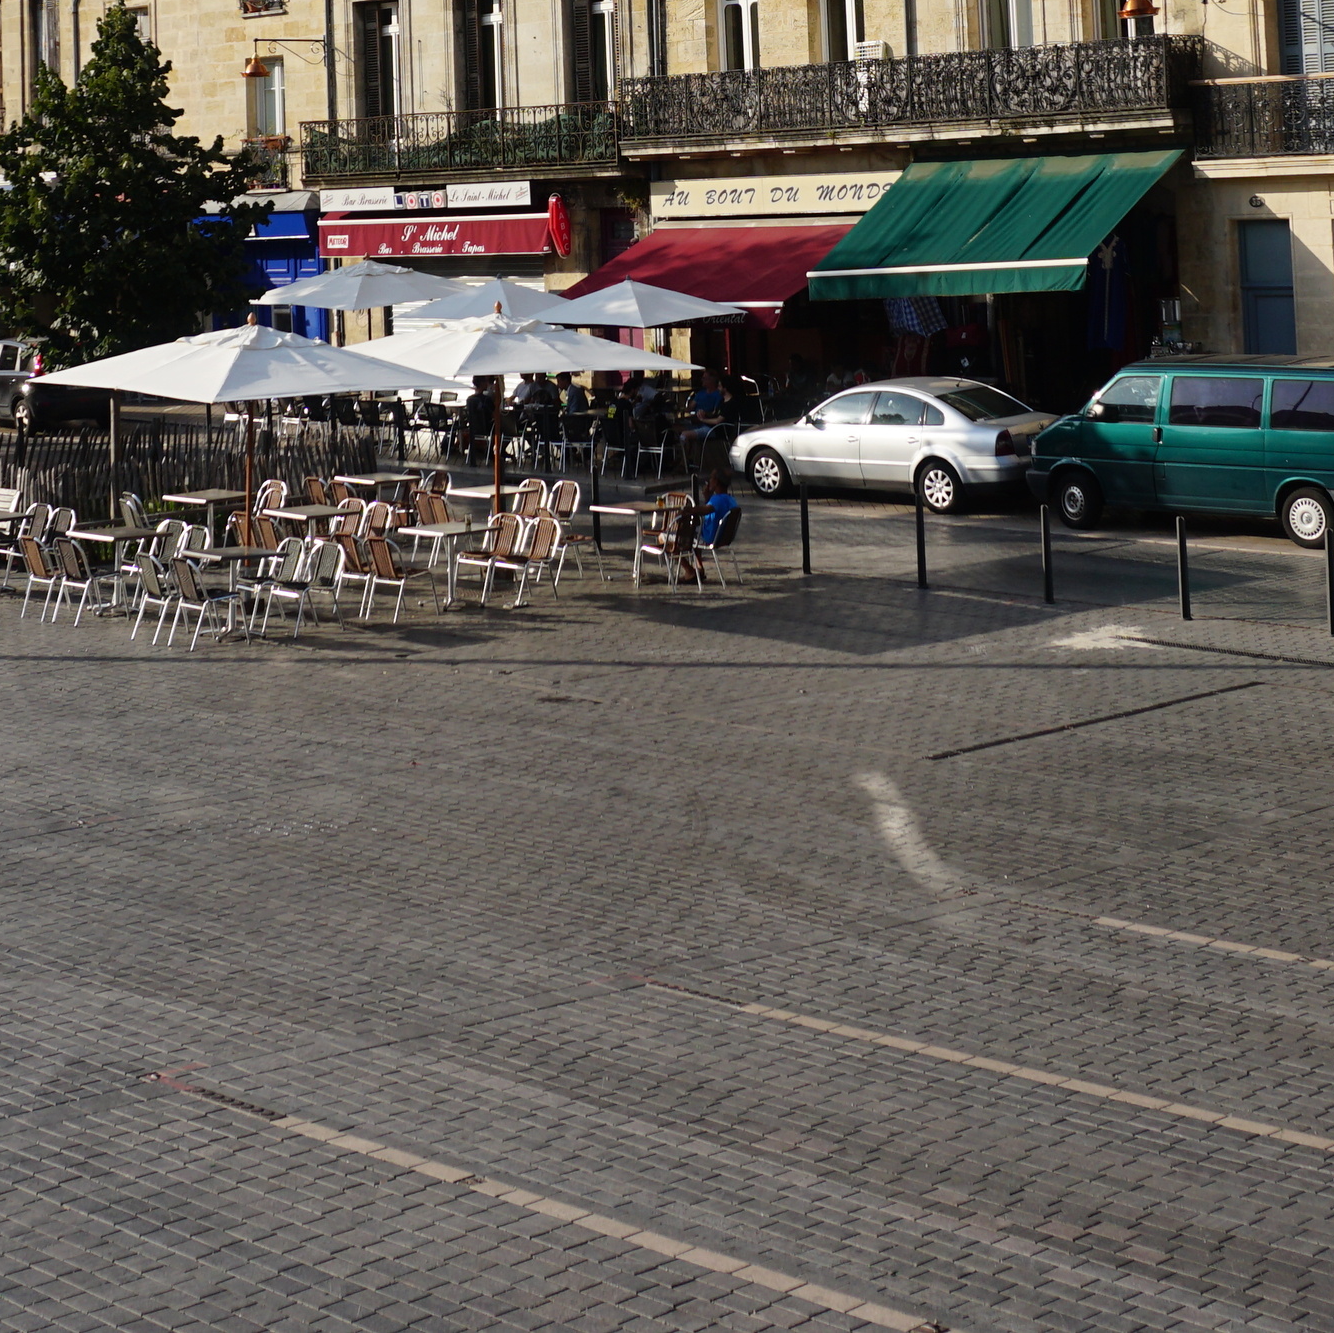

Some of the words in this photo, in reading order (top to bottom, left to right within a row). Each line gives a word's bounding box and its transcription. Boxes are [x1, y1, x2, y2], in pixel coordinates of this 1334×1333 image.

[342, 194, 356, 206] Bar
[358, 193, 388, 205] Brasserie
[449, 189, 459, 203] Le
[663, 191, 691, 207] AU
[705, 187, 757, 206] BOUT
[770, 186, 801, 203] DU
[420, 224, 459, 242] Michel
[557, 201, 570, 251] TABAC
[378, 243, 393, 255] Bar
[412, 242, 444, 254] Brasserie
[462, 241, 485, 255] Tapas
[703, 312, 746, 324] Oriental
